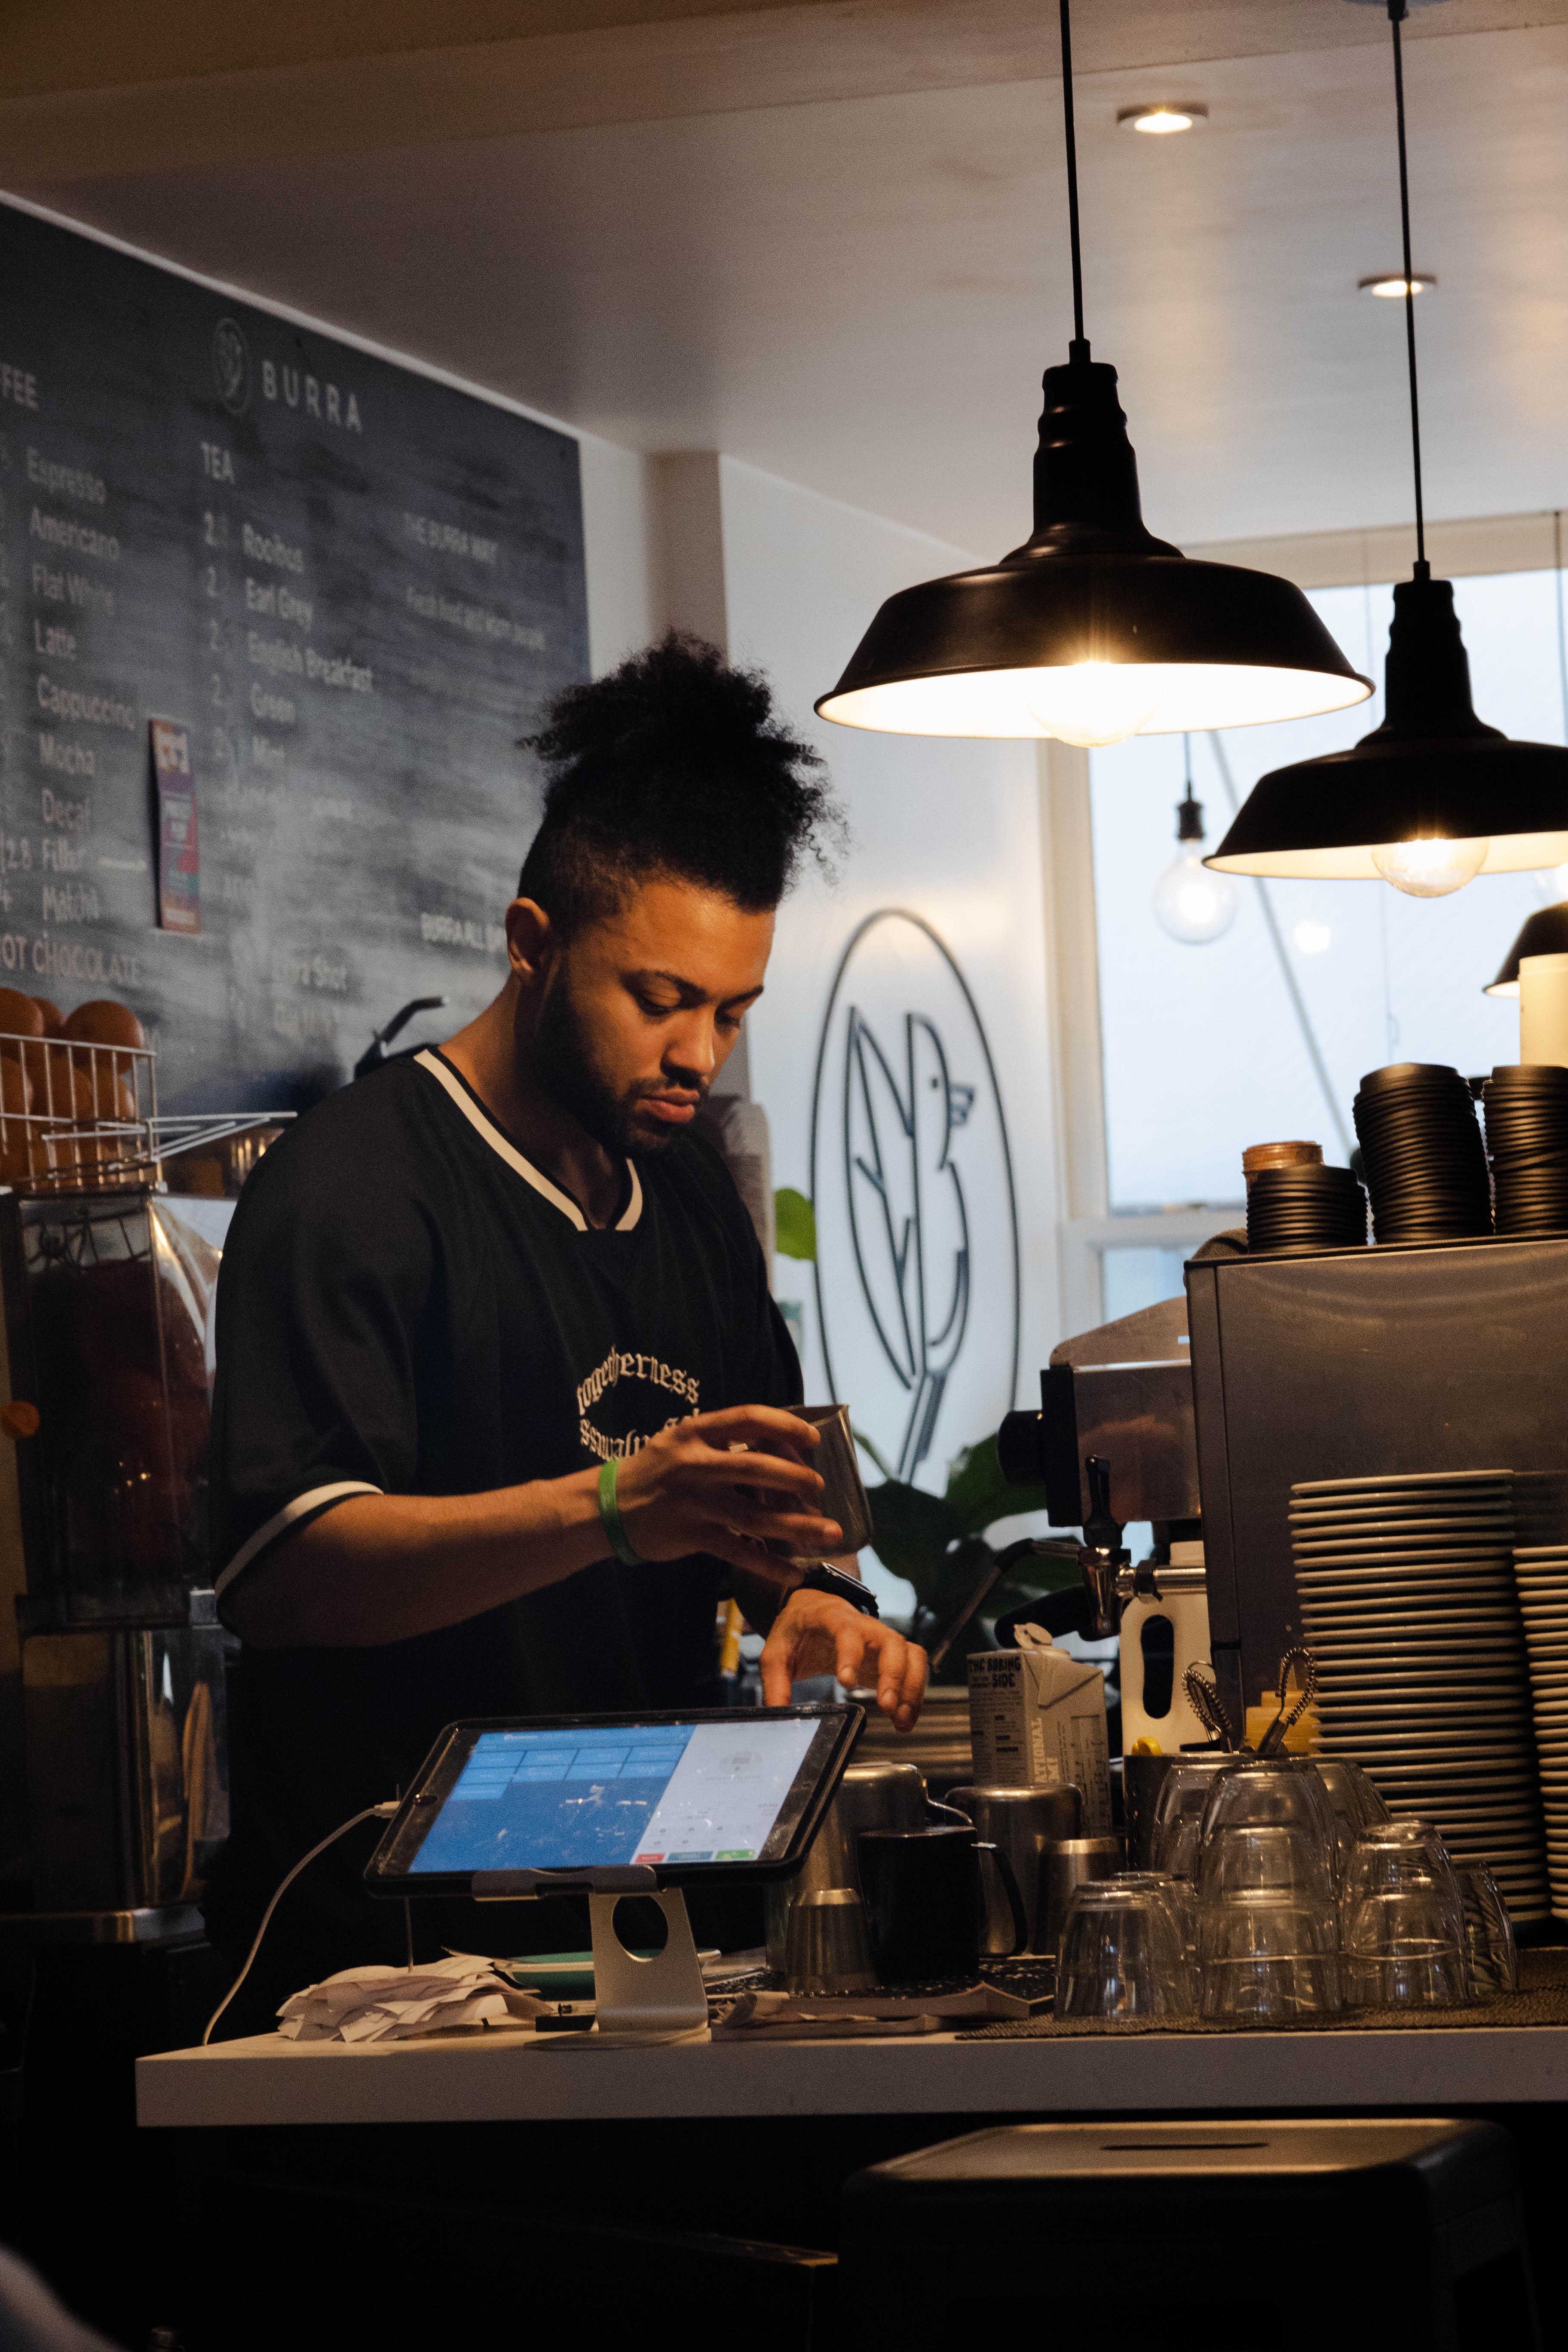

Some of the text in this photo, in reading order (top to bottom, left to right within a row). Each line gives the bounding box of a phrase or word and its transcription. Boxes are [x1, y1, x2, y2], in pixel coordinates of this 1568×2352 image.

[262, 360, 362, 431] BURRA
[201, 441, 235, 485] TEA
[30, 506, 119, 561] Americano
[992, 1673, 1016, 1687] SIDE
